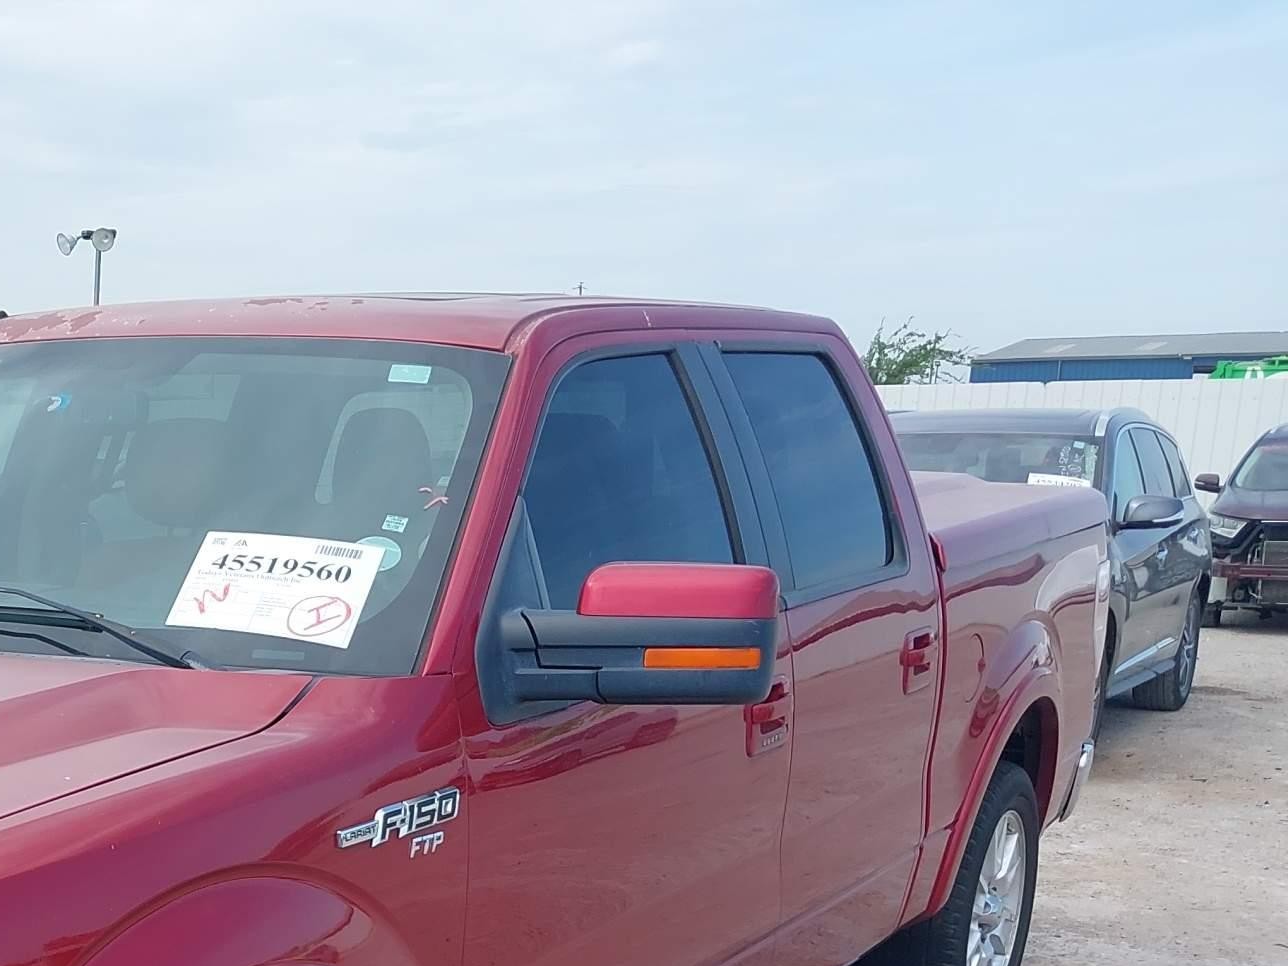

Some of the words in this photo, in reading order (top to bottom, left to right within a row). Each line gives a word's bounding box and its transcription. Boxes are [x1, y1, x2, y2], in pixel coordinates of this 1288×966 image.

[211, 553, 352, 583] 45519560
[344, 824, 377, 842] LARIAT
[409, 831, 445, 859] FTP
